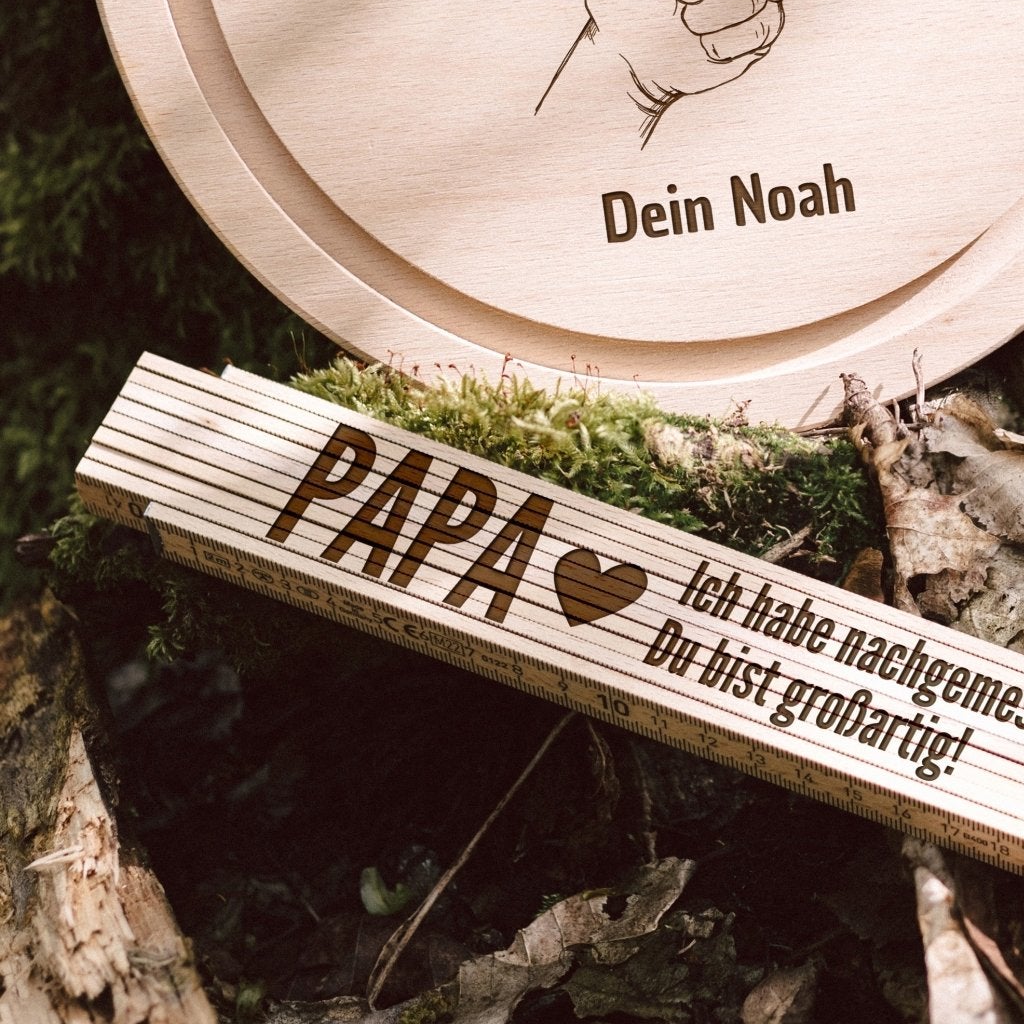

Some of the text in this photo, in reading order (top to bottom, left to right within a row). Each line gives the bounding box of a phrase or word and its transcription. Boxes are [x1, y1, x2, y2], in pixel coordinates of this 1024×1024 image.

[601, 163, 856, 244] Dein Noah
[265, 422, 554, 624] PAPA
[678, 561, 742, 613] Ich
[740, 582, 834, 654] habe
[597, 693, 629, 717] 10
[642, 618, 975, 781] Du bist großartig!
[699, 733, 718, 748] 12
[843, 786, 863, 802] 15
[893, 805, 912, 819] 16
[941, 823, 959, 836] 17
[990, 842, 1009, 856] 18
